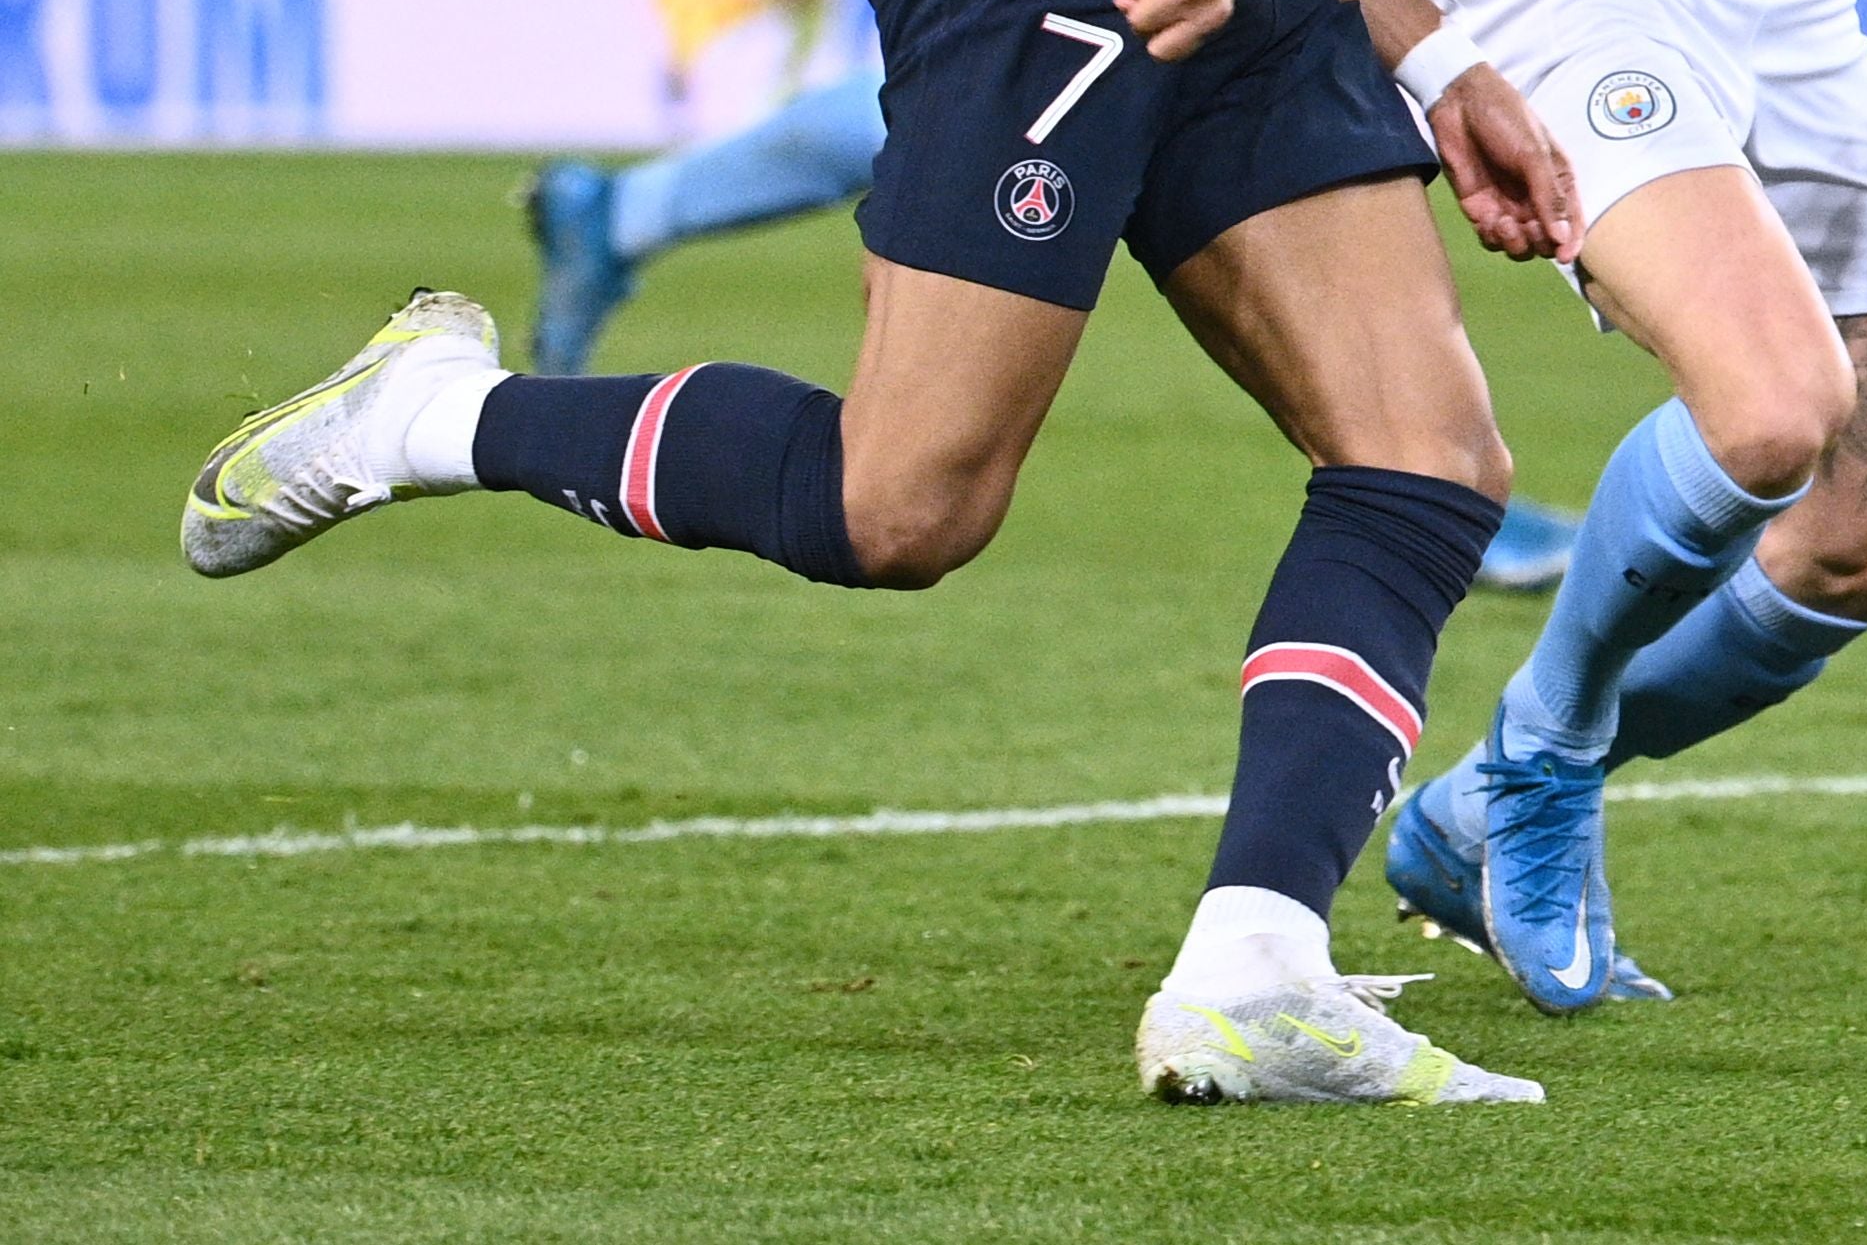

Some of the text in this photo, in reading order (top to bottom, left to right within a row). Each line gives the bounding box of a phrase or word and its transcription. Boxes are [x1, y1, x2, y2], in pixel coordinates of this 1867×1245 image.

[1024, 12, 1125, 145] 7
[1595, 76, 1661, 106] MANCHESTER
[1629, 123, 1652, 133] CITY
[1013, 164, 1067, 189] PARIS
